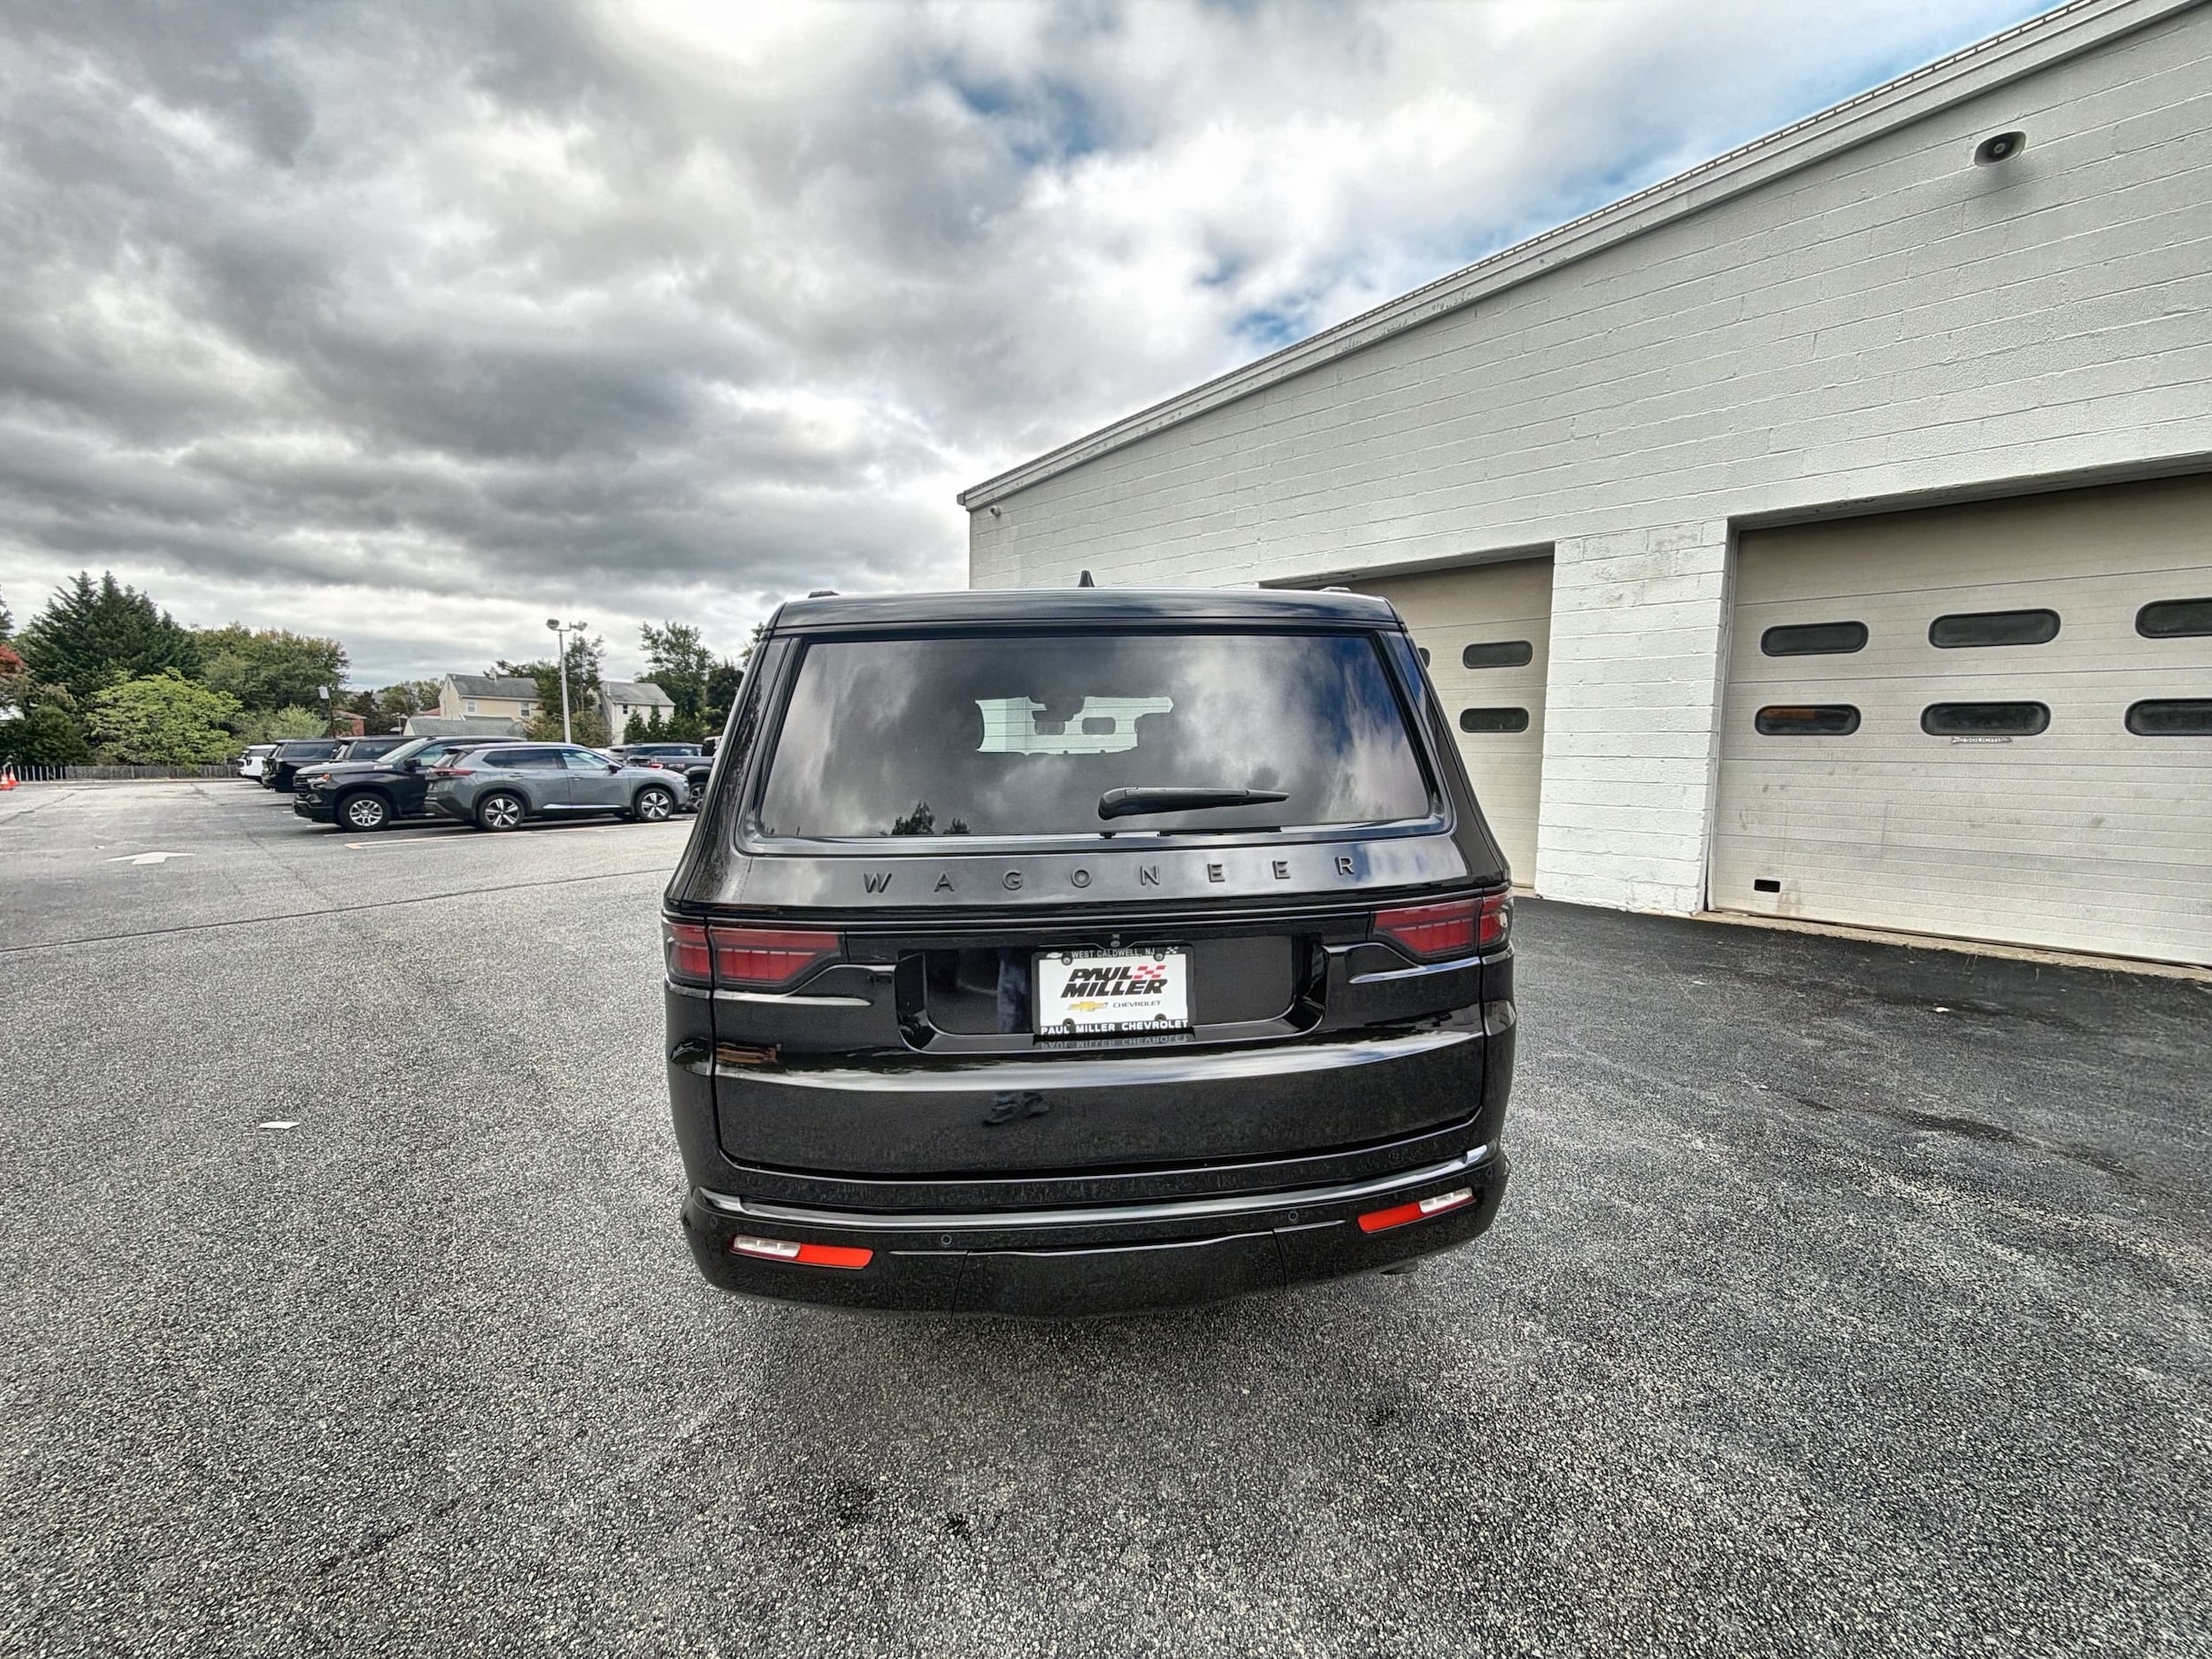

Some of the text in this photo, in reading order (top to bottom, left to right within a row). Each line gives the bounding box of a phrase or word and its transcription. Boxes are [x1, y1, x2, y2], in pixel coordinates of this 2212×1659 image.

[864, 856, 1356, 894] WAGONEER
[1071, 946, 1156, 959] WEST CALDWELL, NJ
[1068, 966, 1133, 982] PAUL
[1060, 979, 1168, 999] MILLER
[1112, 1000, 1161, 1009] CHEVROLET
[1041, 1019, 1189, 1035] PAUL MILLER CHEVROLET
